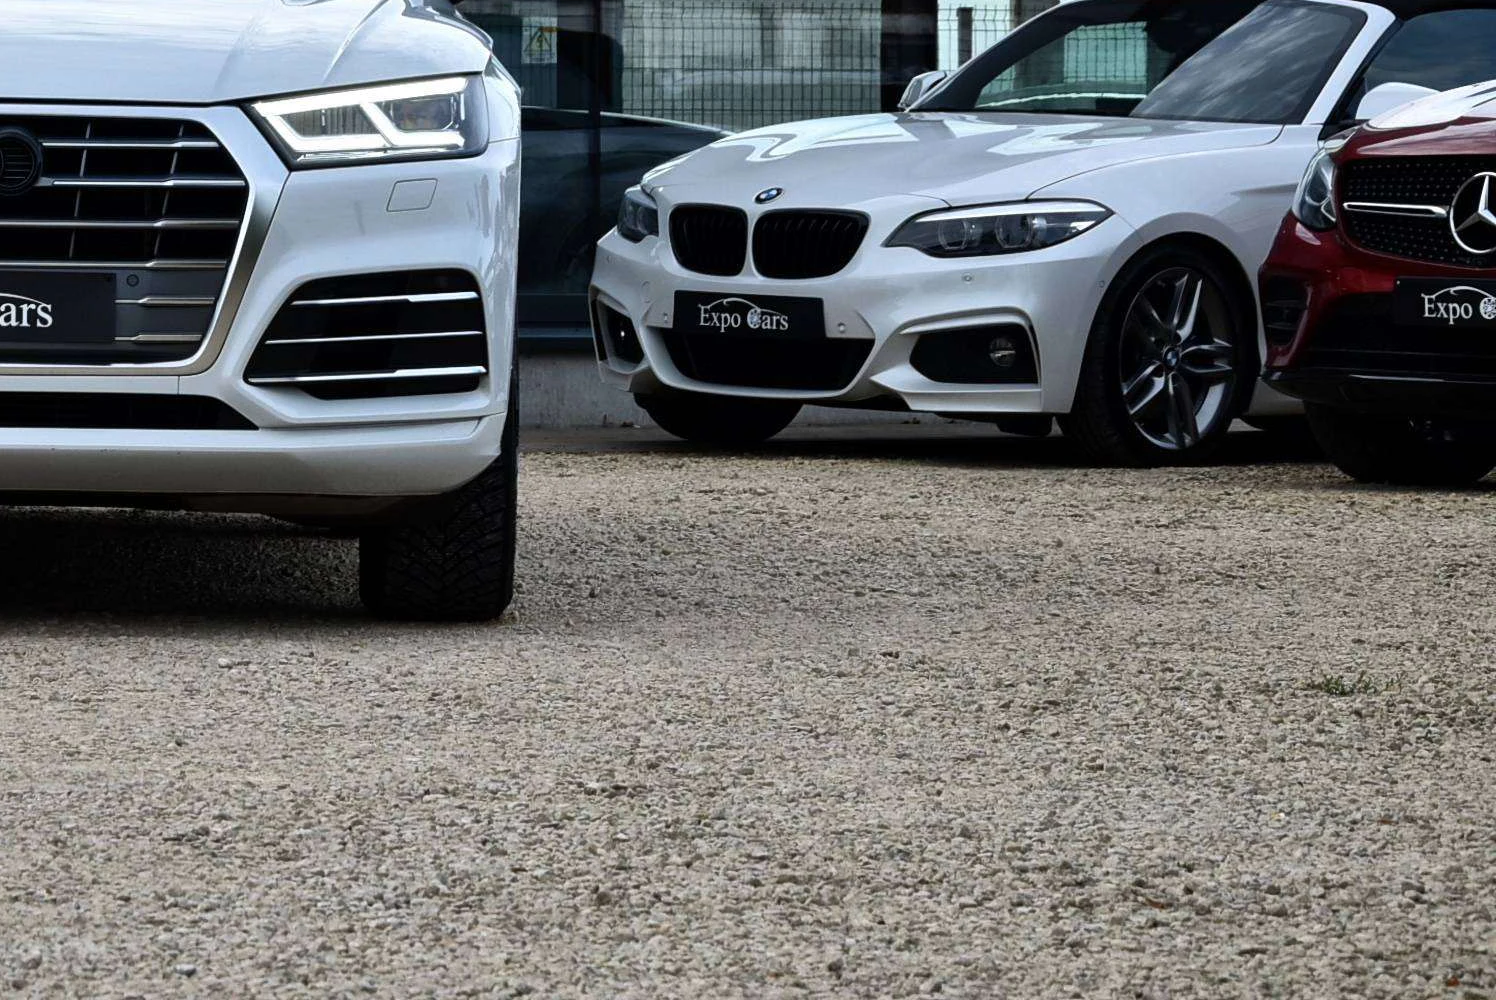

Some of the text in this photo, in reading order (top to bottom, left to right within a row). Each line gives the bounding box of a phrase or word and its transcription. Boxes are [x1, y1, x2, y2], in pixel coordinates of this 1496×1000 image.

[697, 304, 789, 332] Expo Cars
[1420, 293, 1473, 324] Expo
